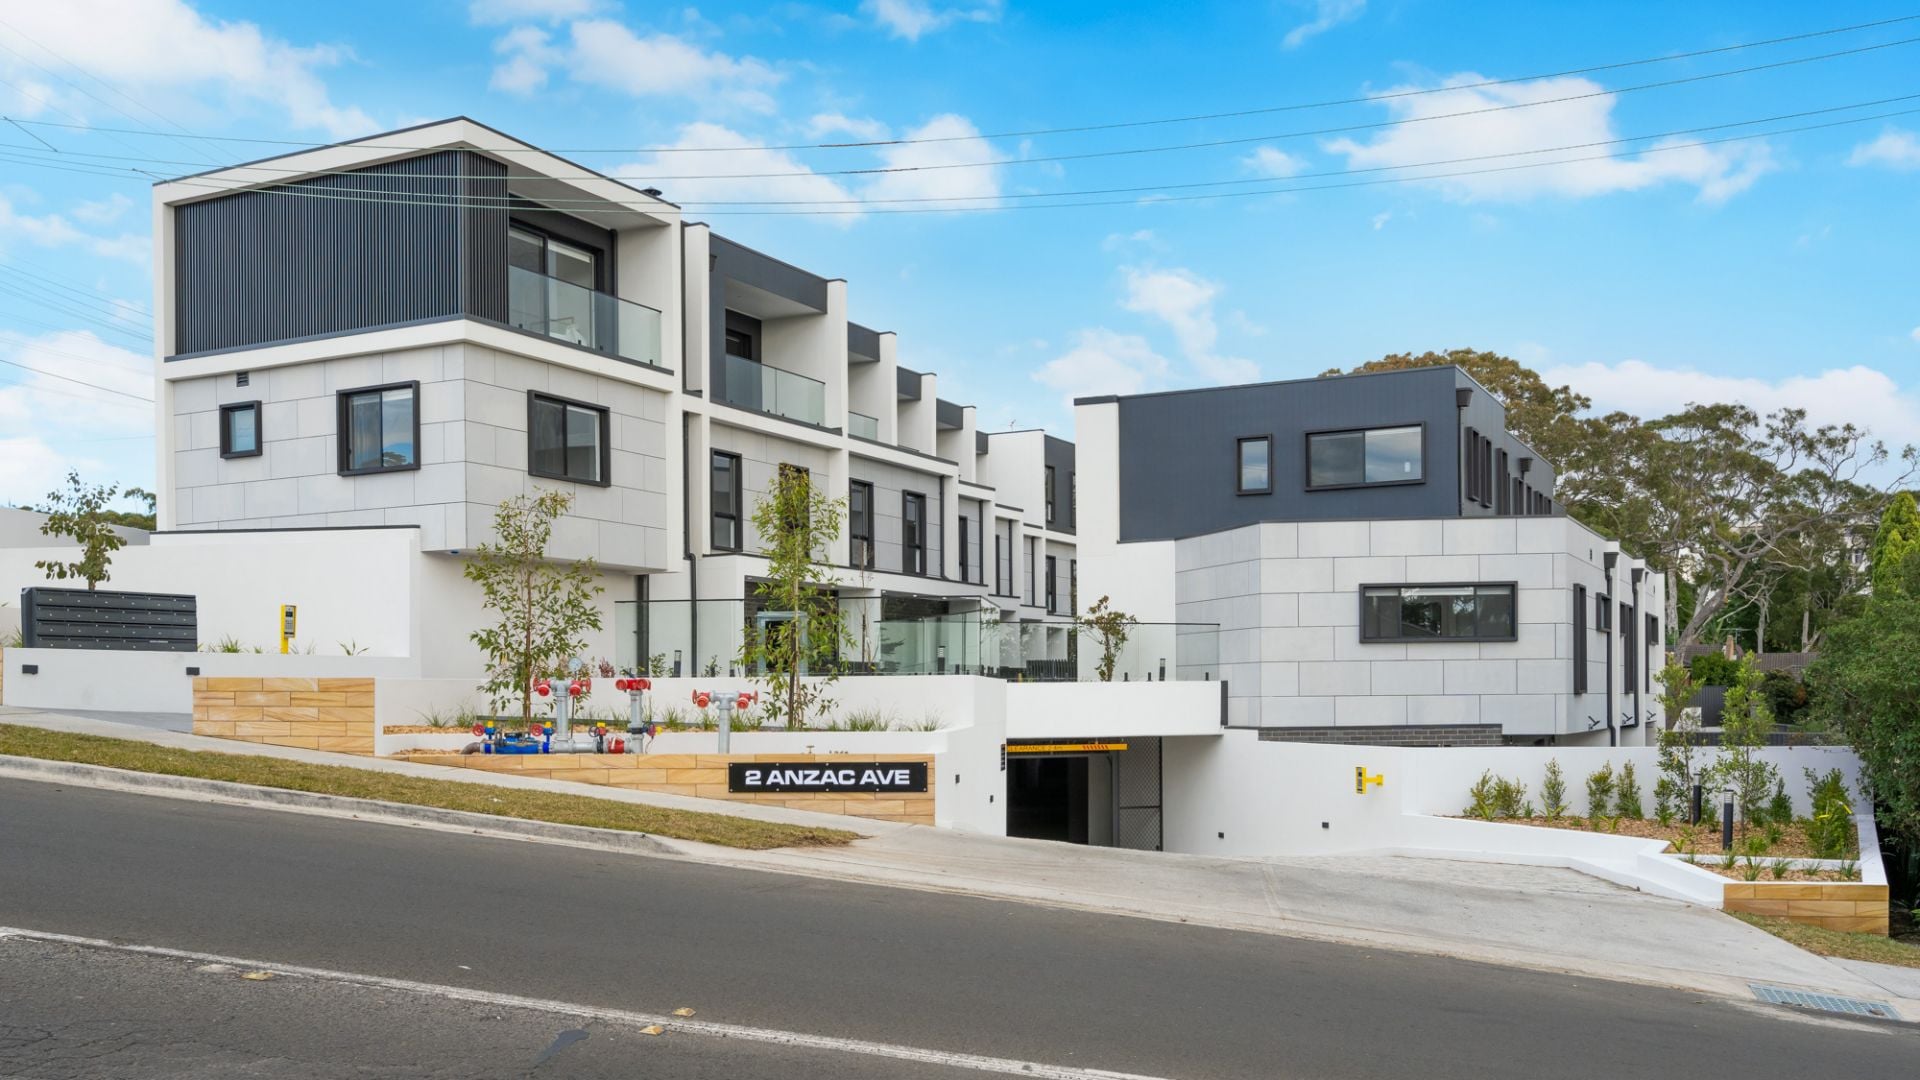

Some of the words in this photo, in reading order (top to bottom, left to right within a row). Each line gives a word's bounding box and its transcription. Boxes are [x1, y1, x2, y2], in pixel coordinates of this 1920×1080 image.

[745, 770, 761, 785] 2
[766, 770, 855, 785] ANZAC
[860, 770, 910, 785] AVE
